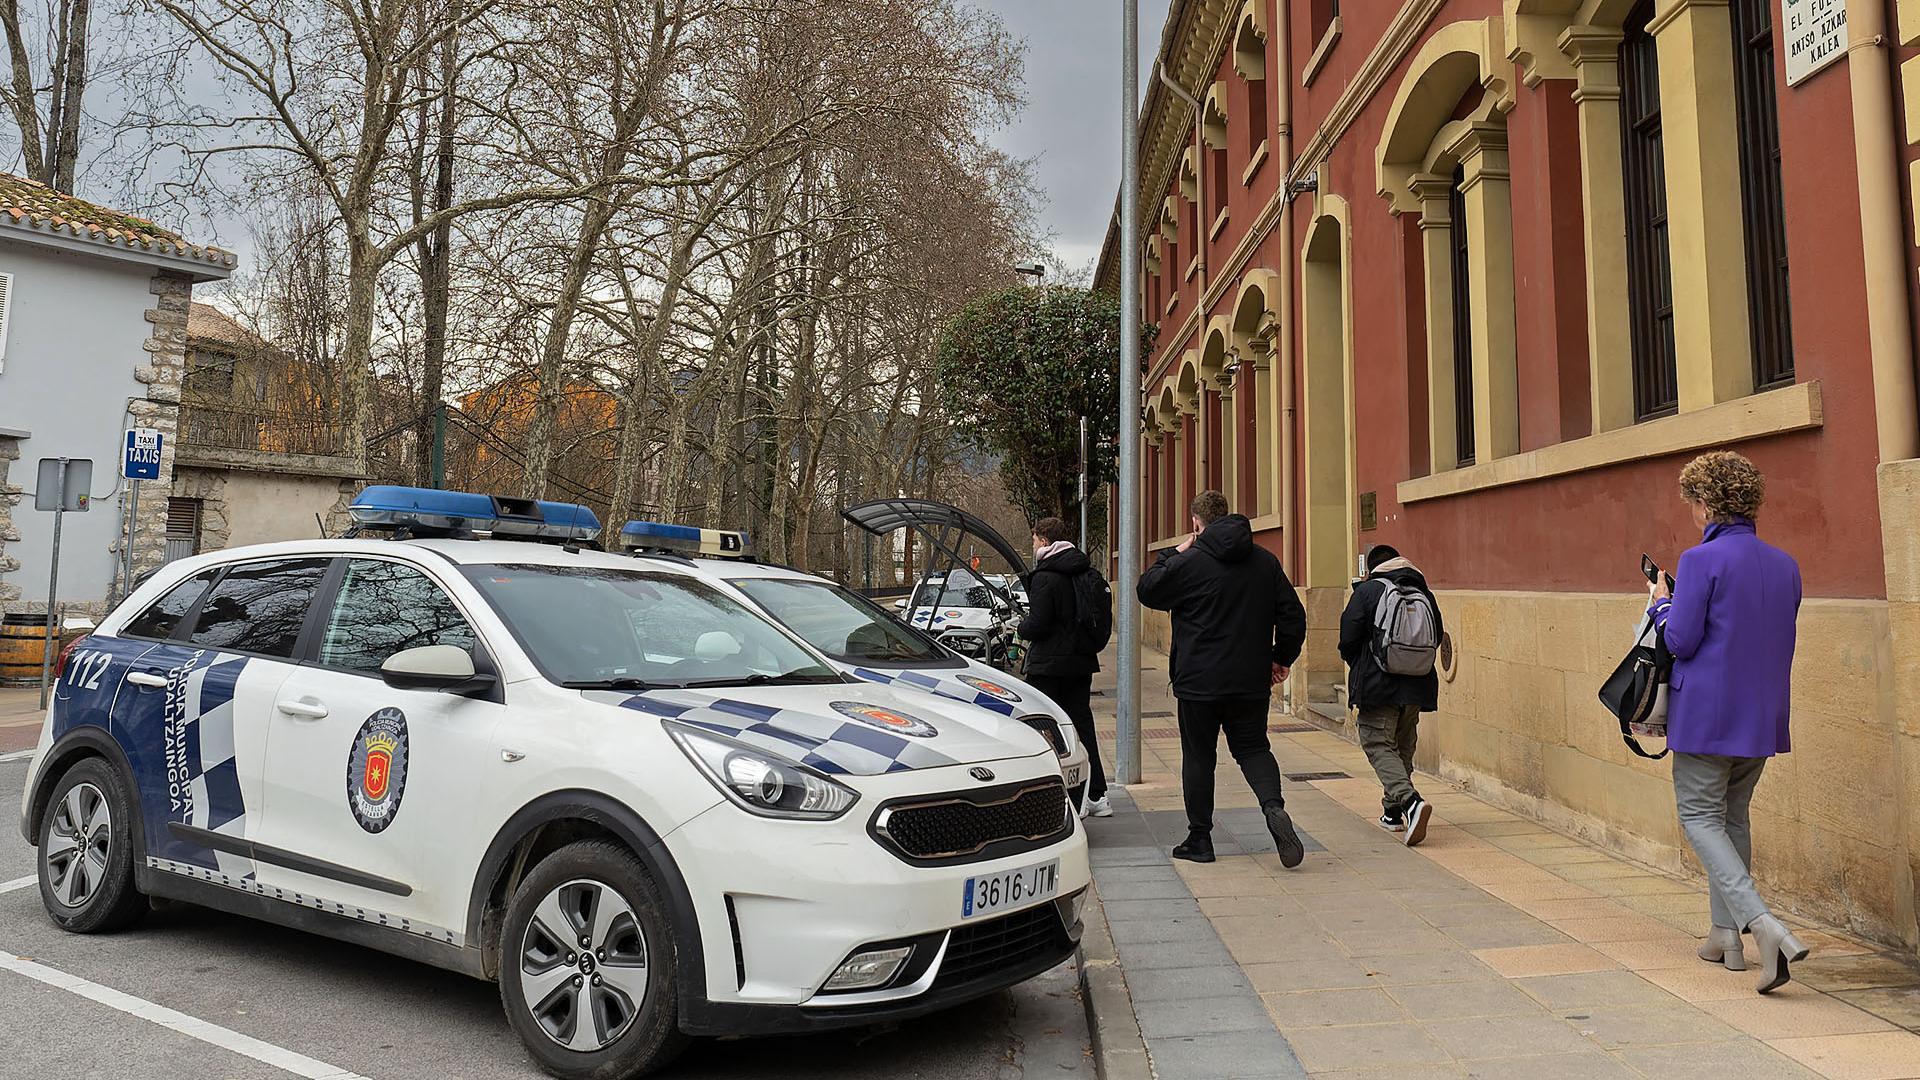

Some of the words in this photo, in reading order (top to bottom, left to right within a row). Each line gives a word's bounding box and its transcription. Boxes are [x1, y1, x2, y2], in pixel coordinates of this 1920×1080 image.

[1791, 13, 1802, 31] EL
[1791, 31, 1815, 57] ANTSO
[1810, 34, 1840, 64] KALEA
[138, 436, 155, 444] TAXI
[128, 447, 160, 464] TAXIS
[68, 649, 113, 690] 112
[164, 666, 181, 812] UDALTZAINGOA
[176, 718, 193, 825] MUNICIPAL
[977, 873, 1022, 909] 3616
[1027, 863, 1056, 897] JTW
[581, 953, 591, 974] KIA
